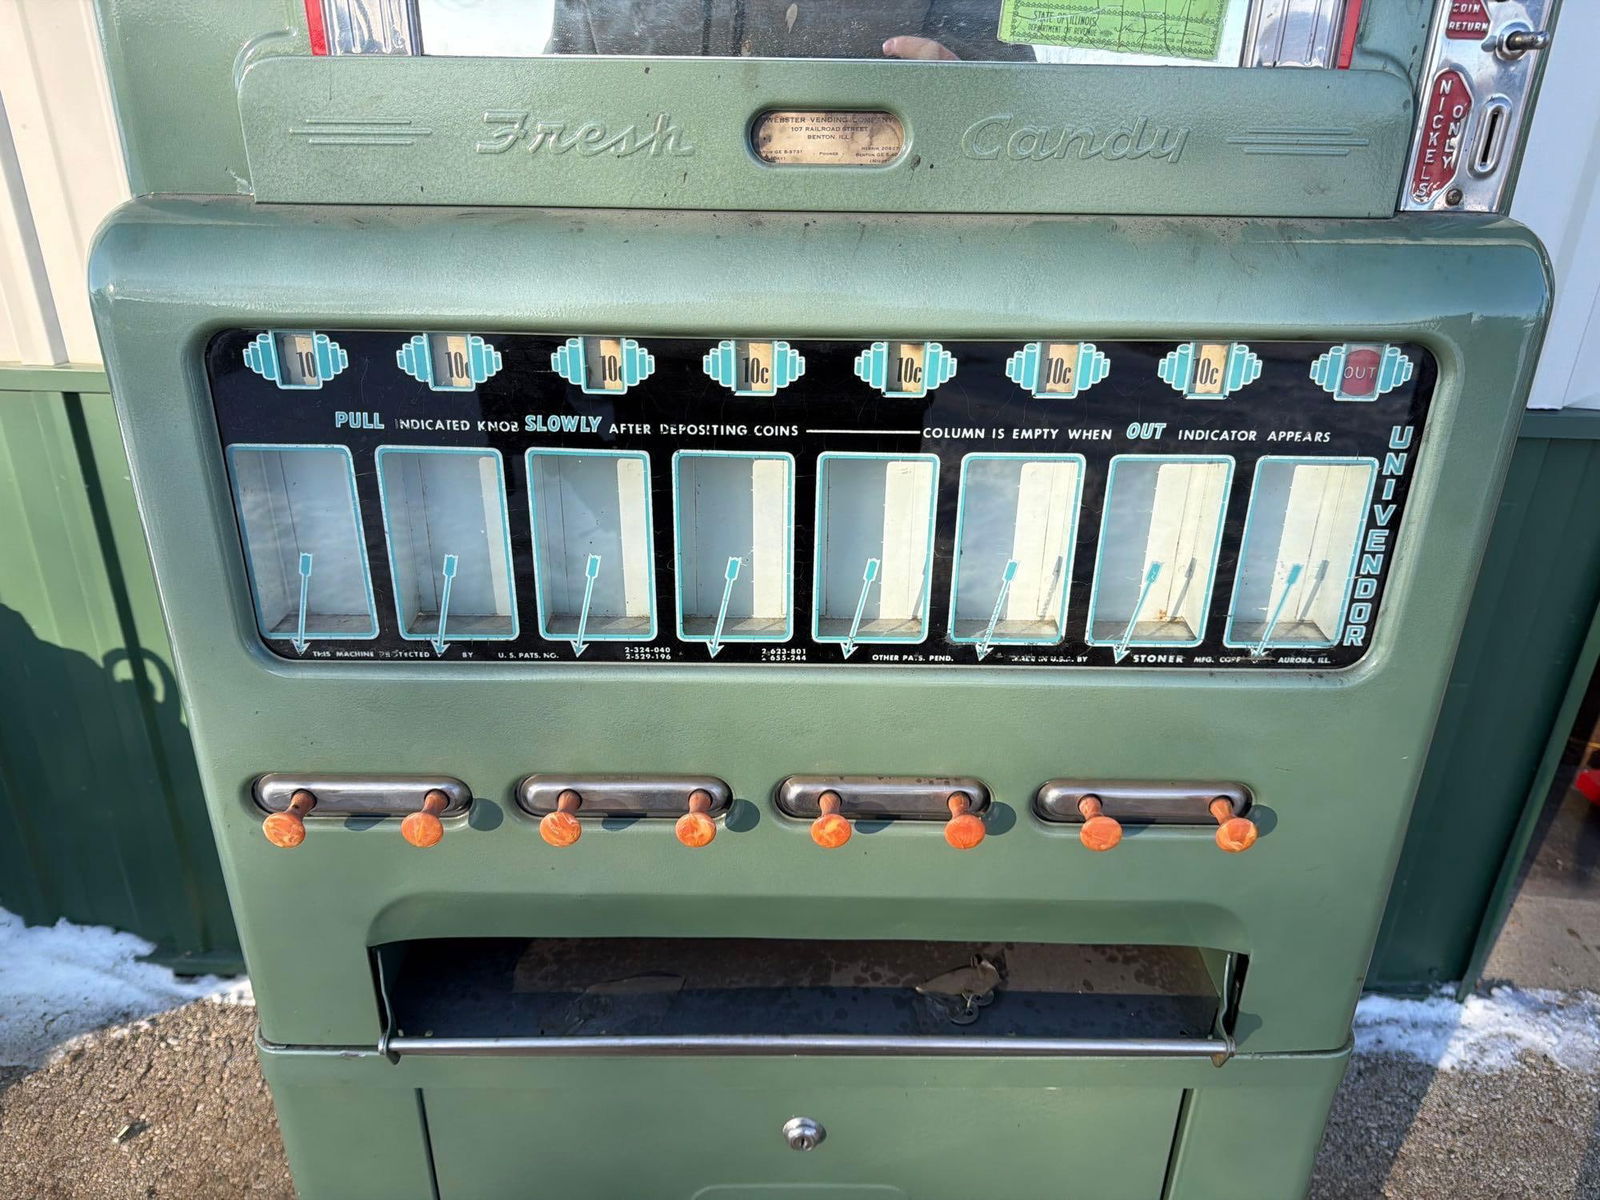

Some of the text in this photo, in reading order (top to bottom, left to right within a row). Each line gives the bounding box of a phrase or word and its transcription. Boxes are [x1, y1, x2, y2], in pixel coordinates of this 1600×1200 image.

[1033, 10, 1054, 23] STATE
[1069, 14, 1097, 26] ILLINOIS
[1452, 3, 1480, 13] COIN
[1448, 21, 1488, 31] RETURN
[810, 116, 848, 124] VENDING
[476, 110, 1191, 164] Fresh Candy
[1417, 79, 1452, 196] NICKELS
[1441, 104, 1463, 169] ONLY
[743, 357, 769, 384] 10c
[897, 357, 923, 384] 10c
[1046, 357, 1072, 385] 10c
[1192, 357, 1219, 385] 10c
[1343, 365, 1376, 380] OUT
[334, 410, 1331, 443] PULL INDICATED KNOB SLOWLY AFTER DEPOSITING COINS COLUMN IS EMPTY WHEN OUT INDICATOR APPEARS
[1342, 425, 1414, 647] UNIVENDOR
[543, 652, 559, 660] NO.
[1076, 655, 1088, 663] BY
[1133, 654, 1184, 663] STONER
